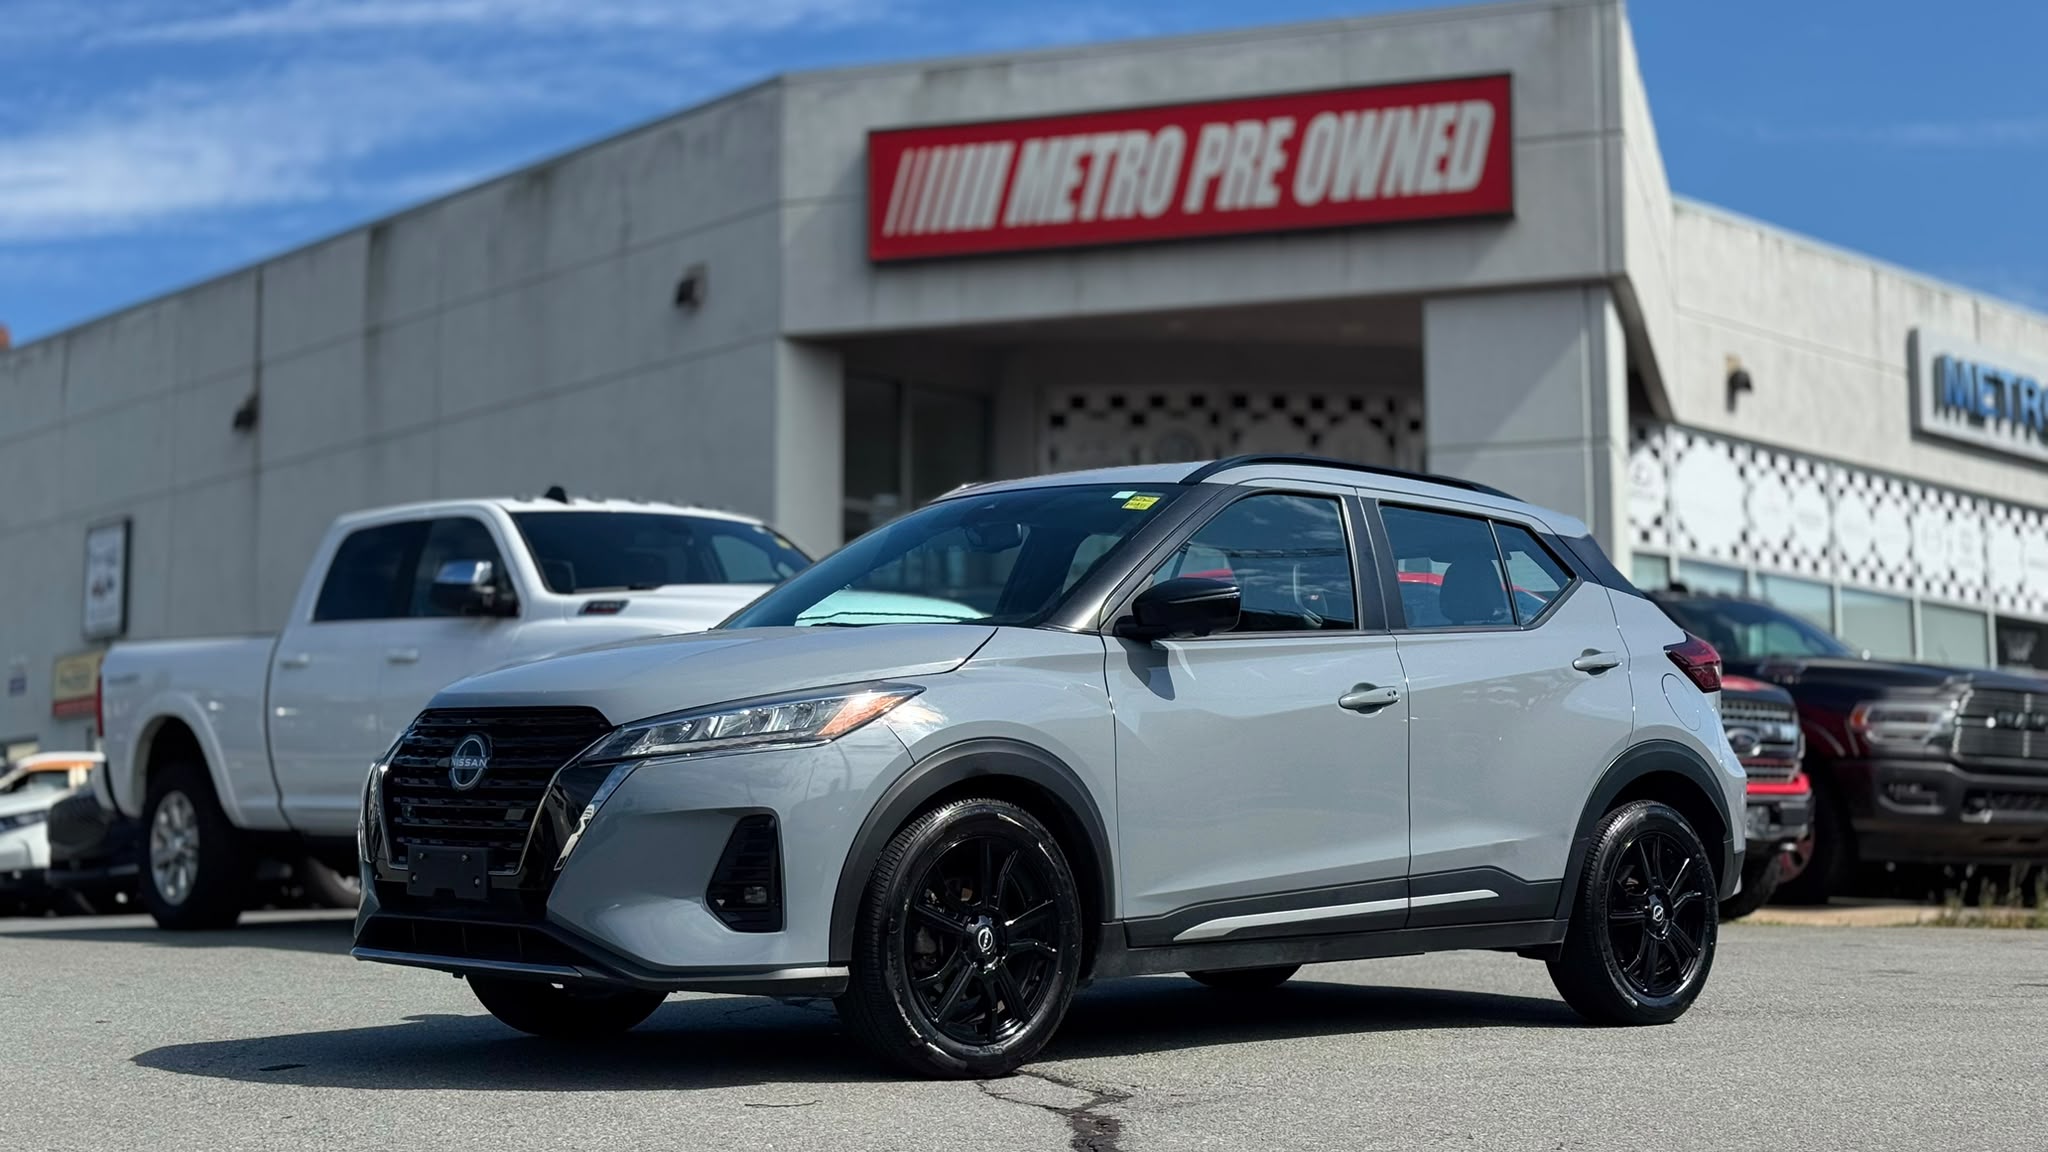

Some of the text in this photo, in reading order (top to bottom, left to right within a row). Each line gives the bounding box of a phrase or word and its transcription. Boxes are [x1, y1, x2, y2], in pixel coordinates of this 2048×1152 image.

[1003, 100, 1495, 229] METRO PRE OWNED
[1940, 353, 2048, 434] METR
[452, 758, 488, 768] NISSAN
